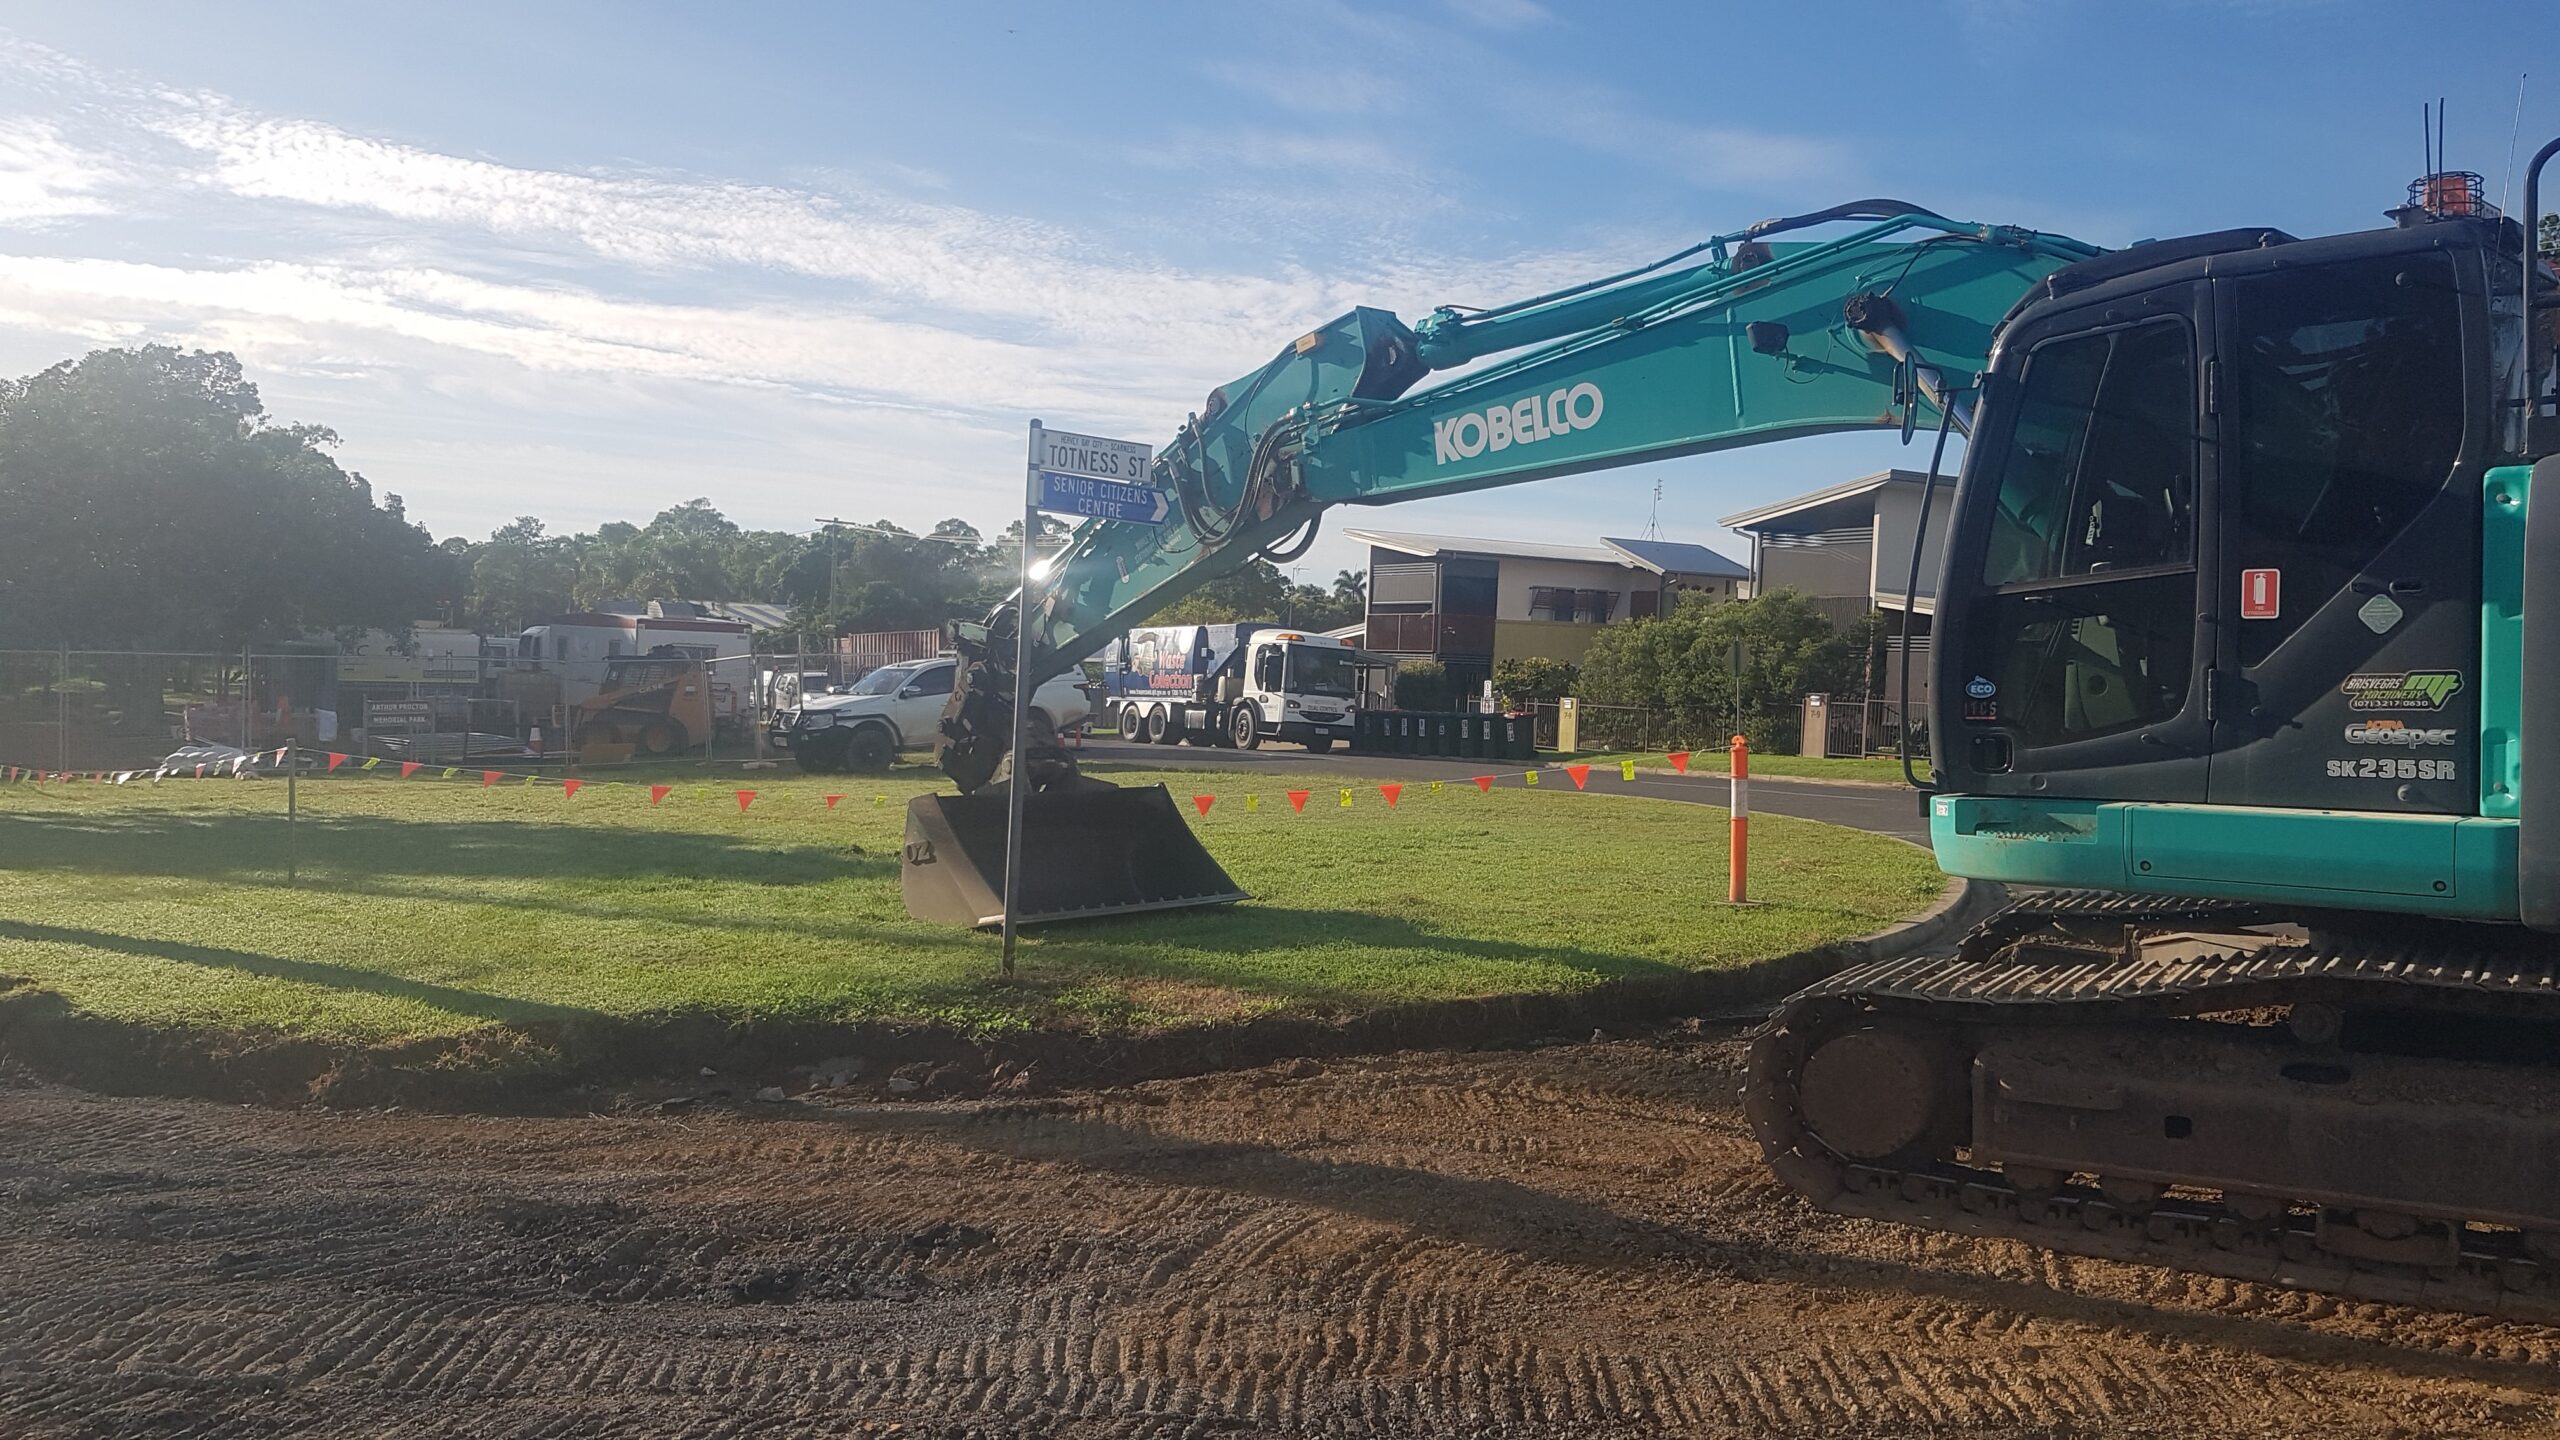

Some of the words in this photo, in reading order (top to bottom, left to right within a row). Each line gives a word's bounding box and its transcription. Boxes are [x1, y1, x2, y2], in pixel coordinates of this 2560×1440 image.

[1433, 382, 1604, 466] KOBELCO
[1049, 445, 1119, 474] TOTNESS
[1128, 456, 1146, 478] ST
[1053, 476, 1095, 497] SENIOR
[1100, 482, 1148, 505] CITIZENS
[1078, 498, 1123, 518] CENTRE
[1159, 650, 1185, 669] Waste
[1149, 670, 1193, 689] Collection
[1971, 684, 1992, 694] ECO
[2346, 678, 2402, 690] BRISVEGAS
[2362, 690, 2425, 699] MACHINERY
